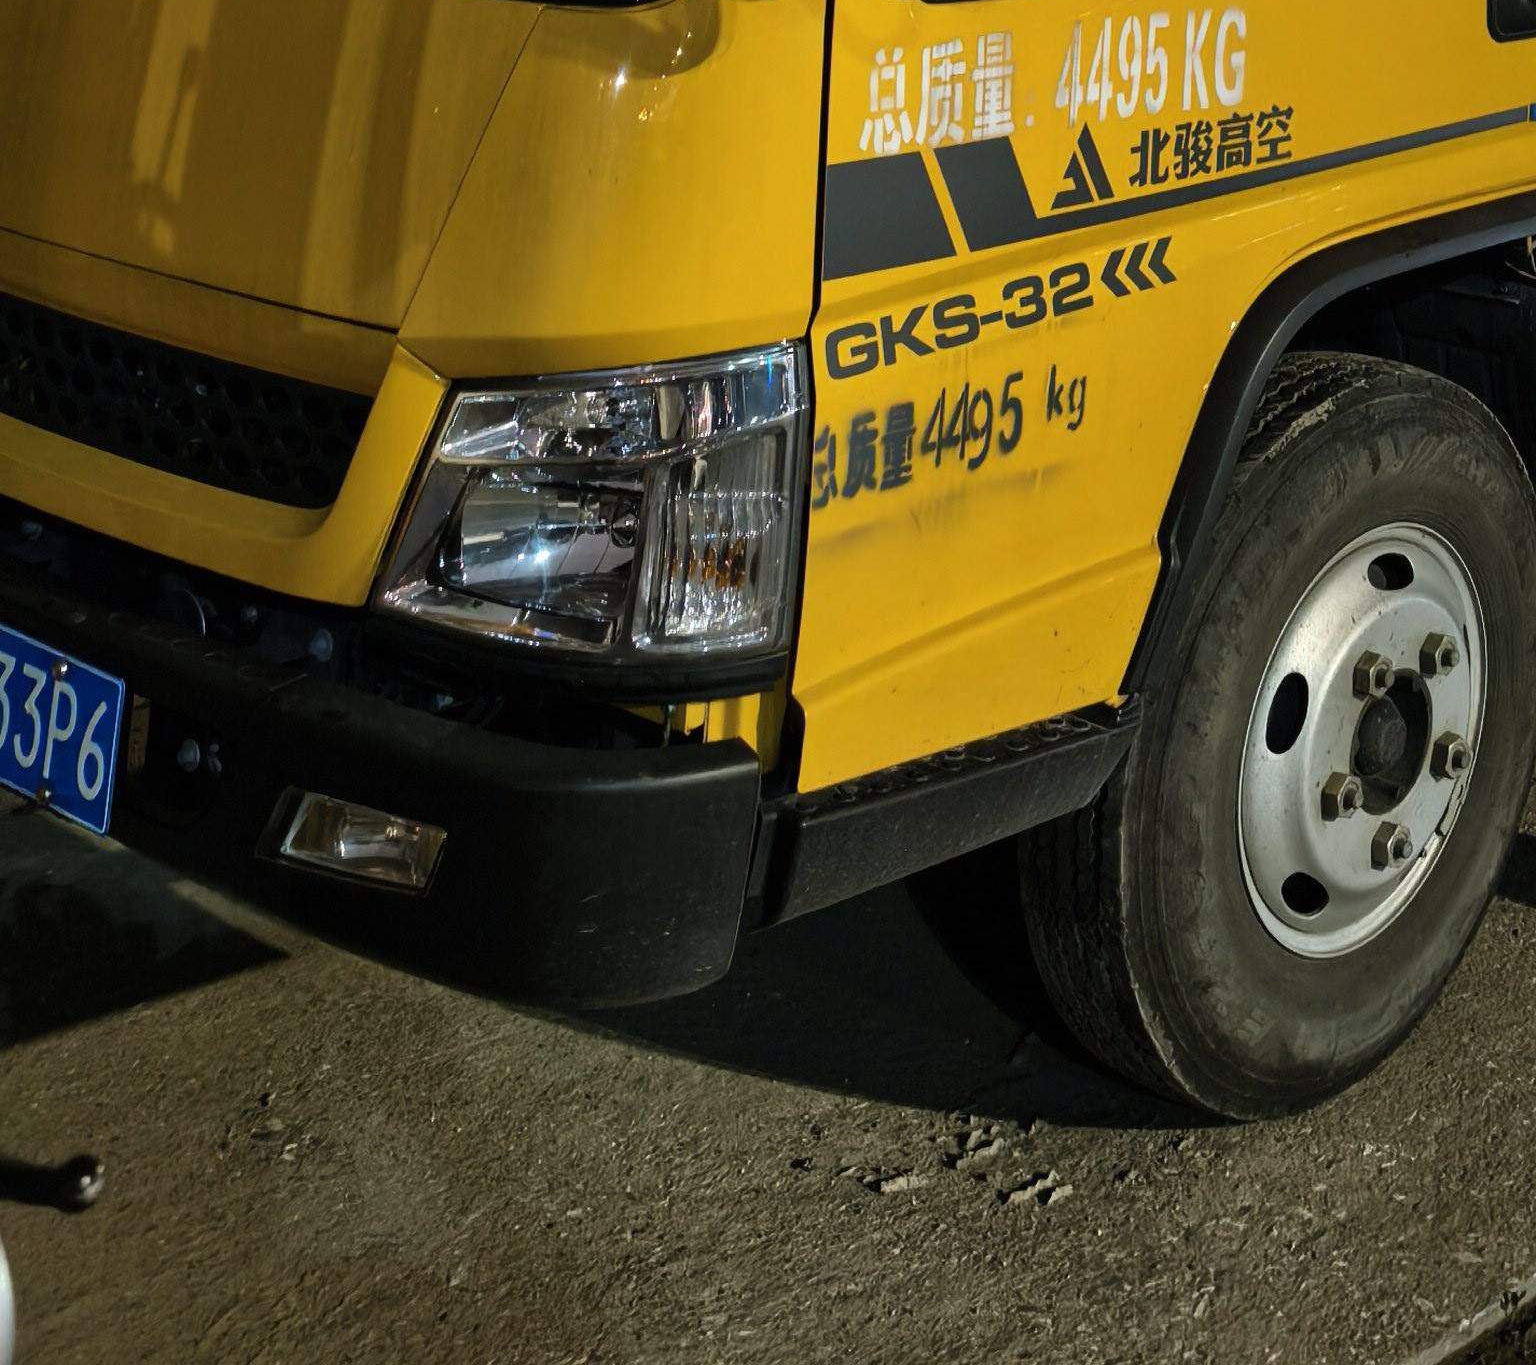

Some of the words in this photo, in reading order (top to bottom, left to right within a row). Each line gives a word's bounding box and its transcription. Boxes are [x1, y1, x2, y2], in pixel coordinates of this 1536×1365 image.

[1053, 12, 1170, 128] 4495
[1183, 5, 1247, 111] KG
[1128, 105, 1295, 188] 北骏高空
[825, 262, 1094, 381] GKS-32
[1045, 362, 1088, 432] kg
